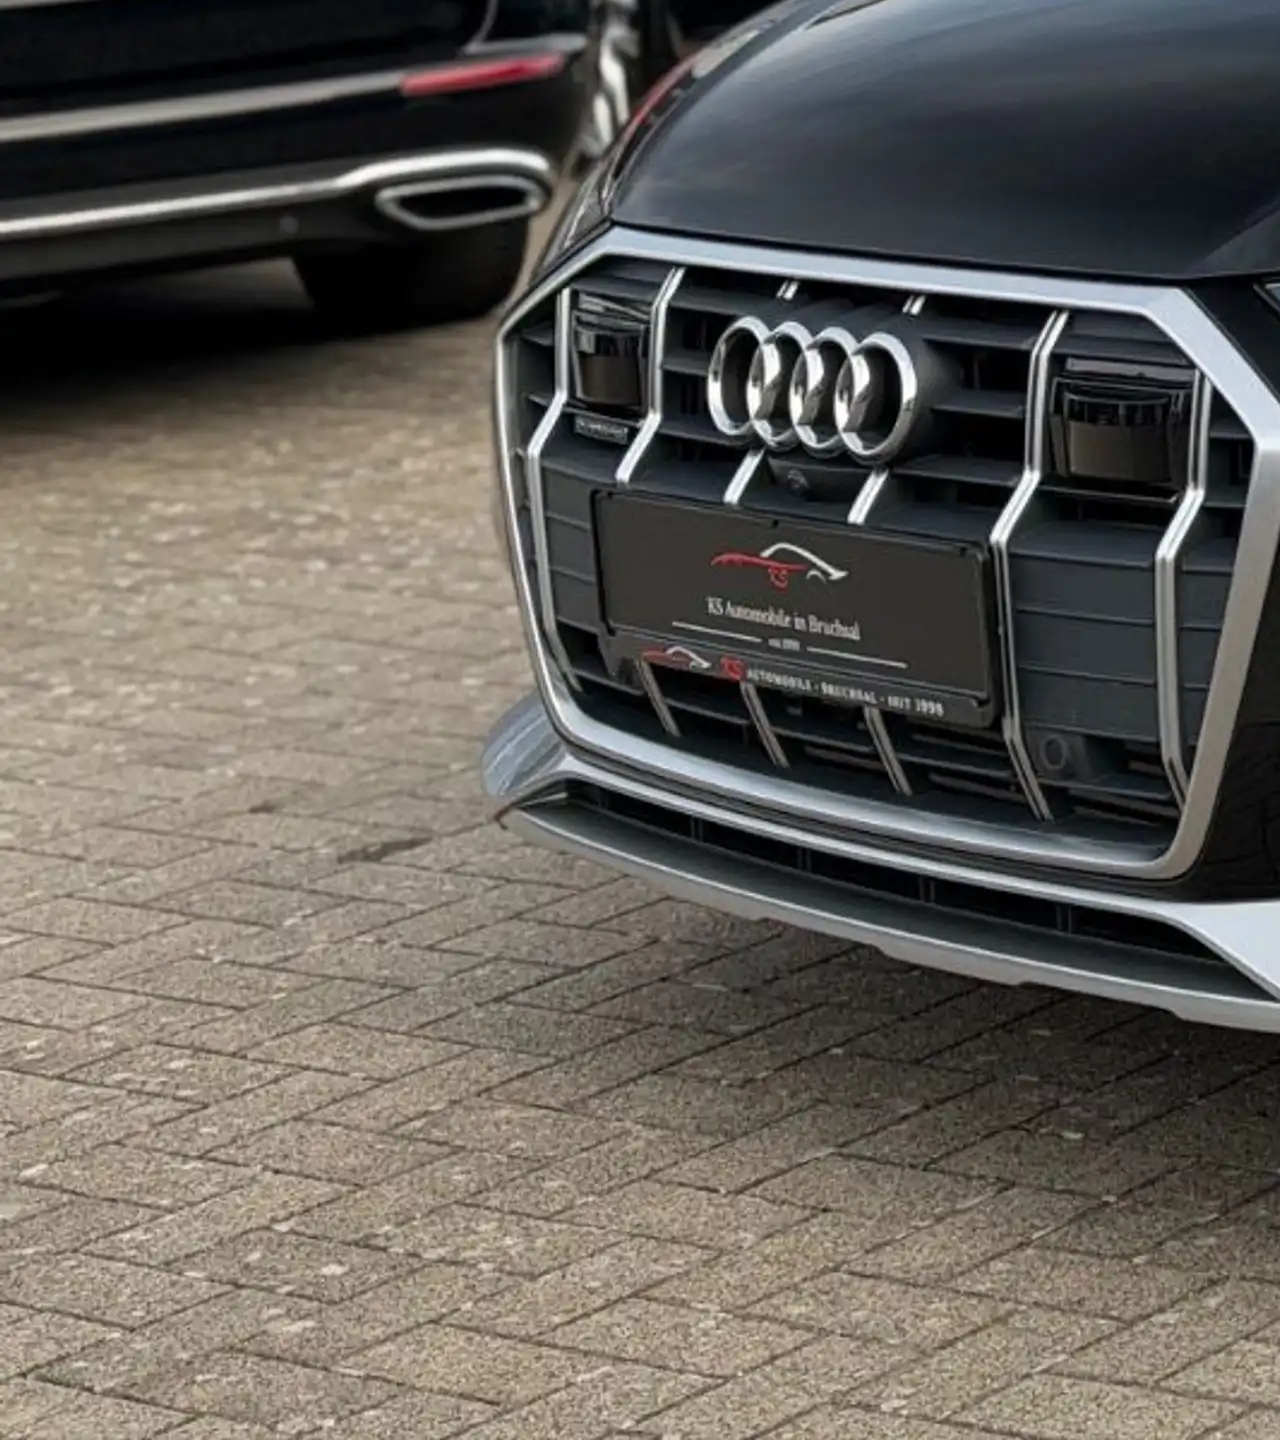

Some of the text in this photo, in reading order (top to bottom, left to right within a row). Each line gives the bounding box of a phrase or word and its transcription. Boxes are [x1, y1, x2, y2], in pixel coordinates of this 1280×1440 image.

[725, 599, 792, 628] Automobile
[793, 611, 808, 631] in
[808, 614, 861, 641] Bruchsal
